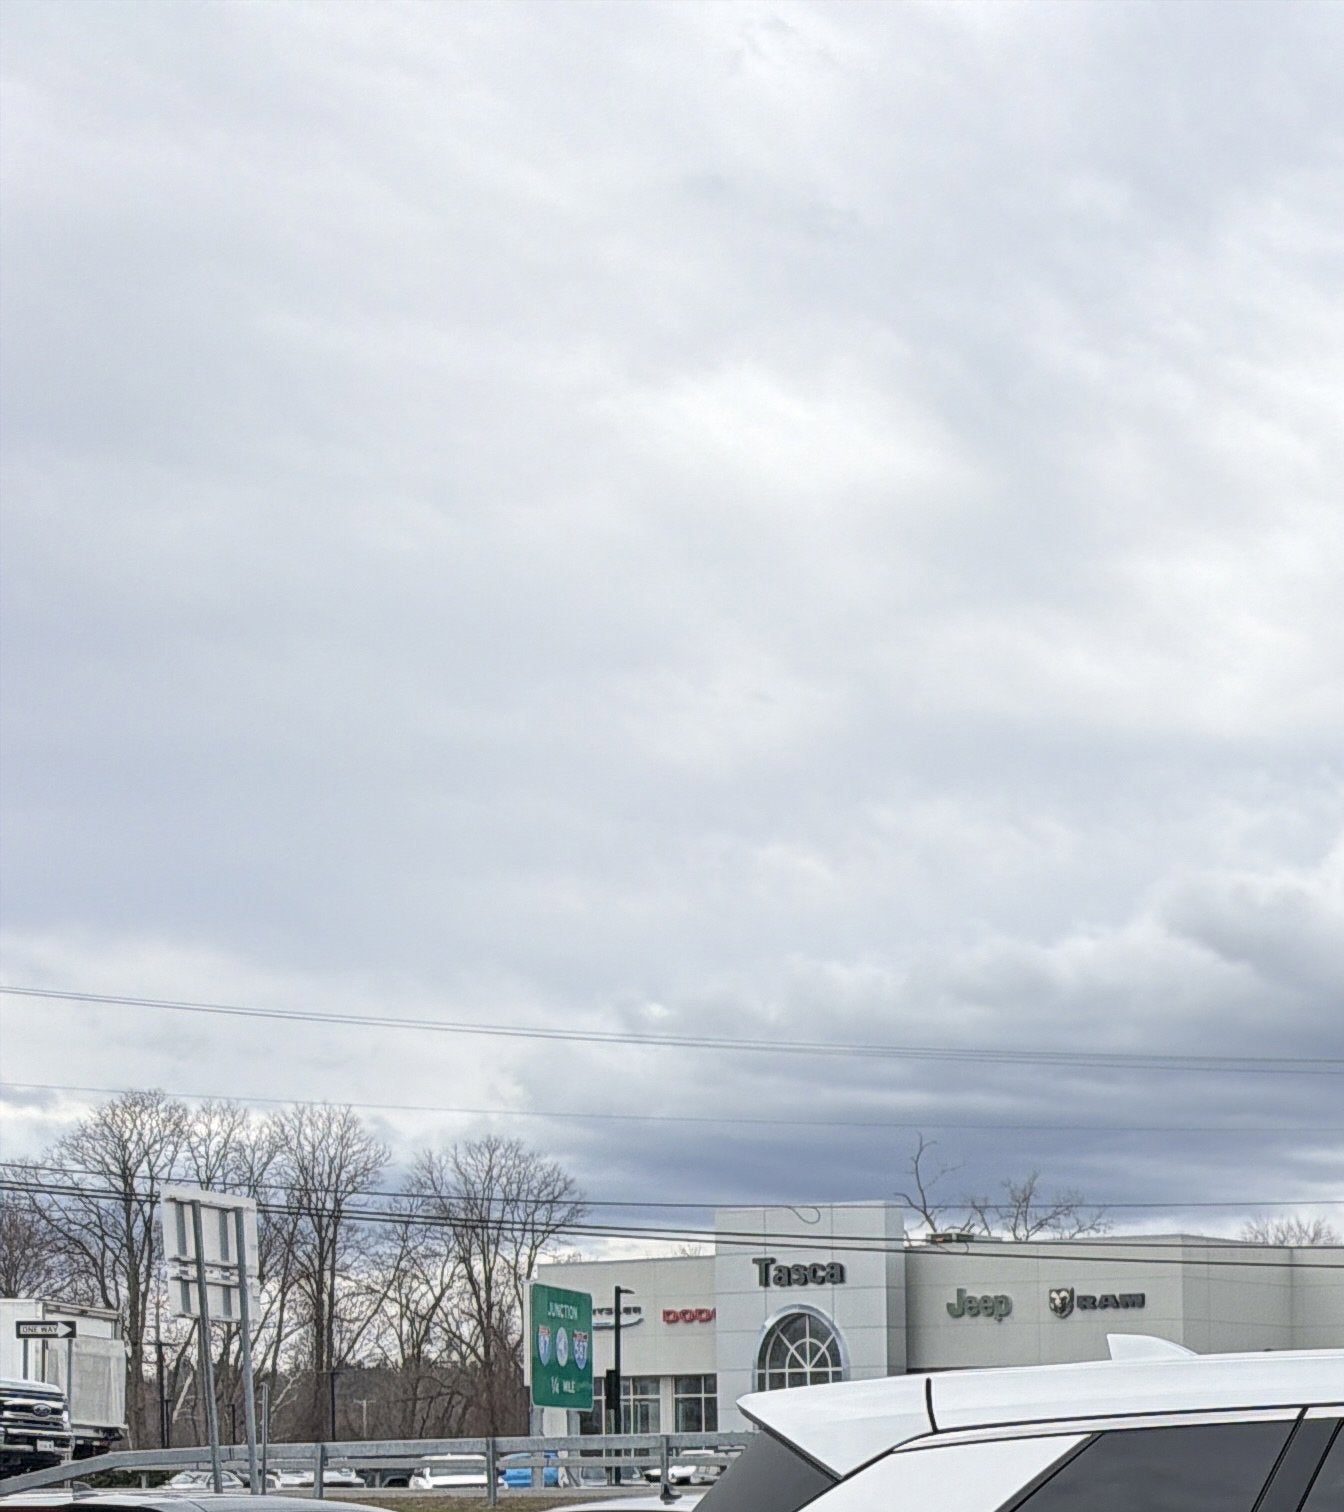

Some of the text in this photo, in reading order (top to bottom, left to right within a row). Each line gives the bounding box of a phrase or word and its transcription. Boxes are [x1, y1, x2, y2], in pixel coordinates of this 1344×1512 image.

[752, 1257, 845, 1288] Tasca
[947, 1287, 1146, 1322] Jeep RAM
[22, 1326, 38, 1334] ONE
